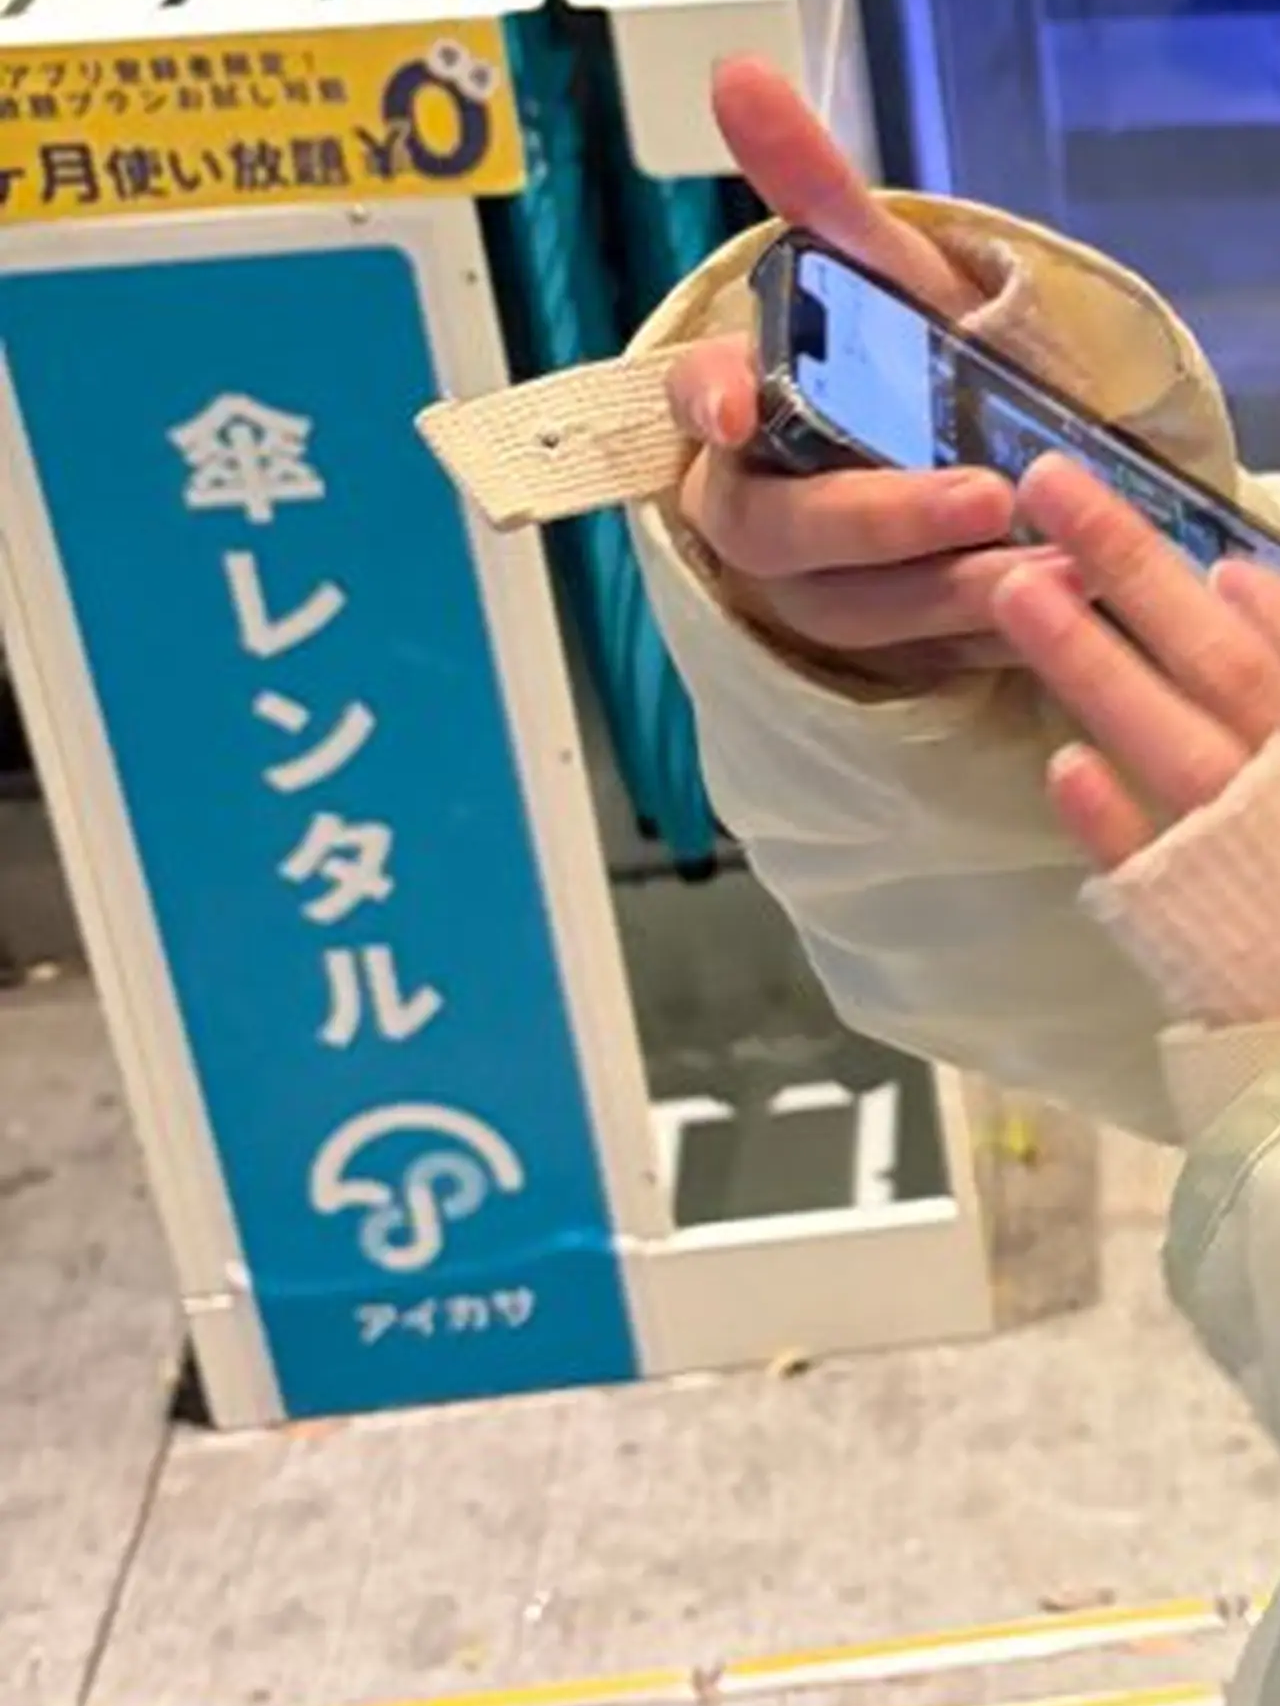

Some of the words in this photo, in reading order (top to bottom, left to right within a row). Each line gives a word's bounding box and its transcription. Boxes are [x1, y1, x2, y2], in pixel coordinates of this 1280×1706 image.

[166, 392, 442, 1049] 傘レンタル
[353, 1284, 536, 1347] アイカサ
